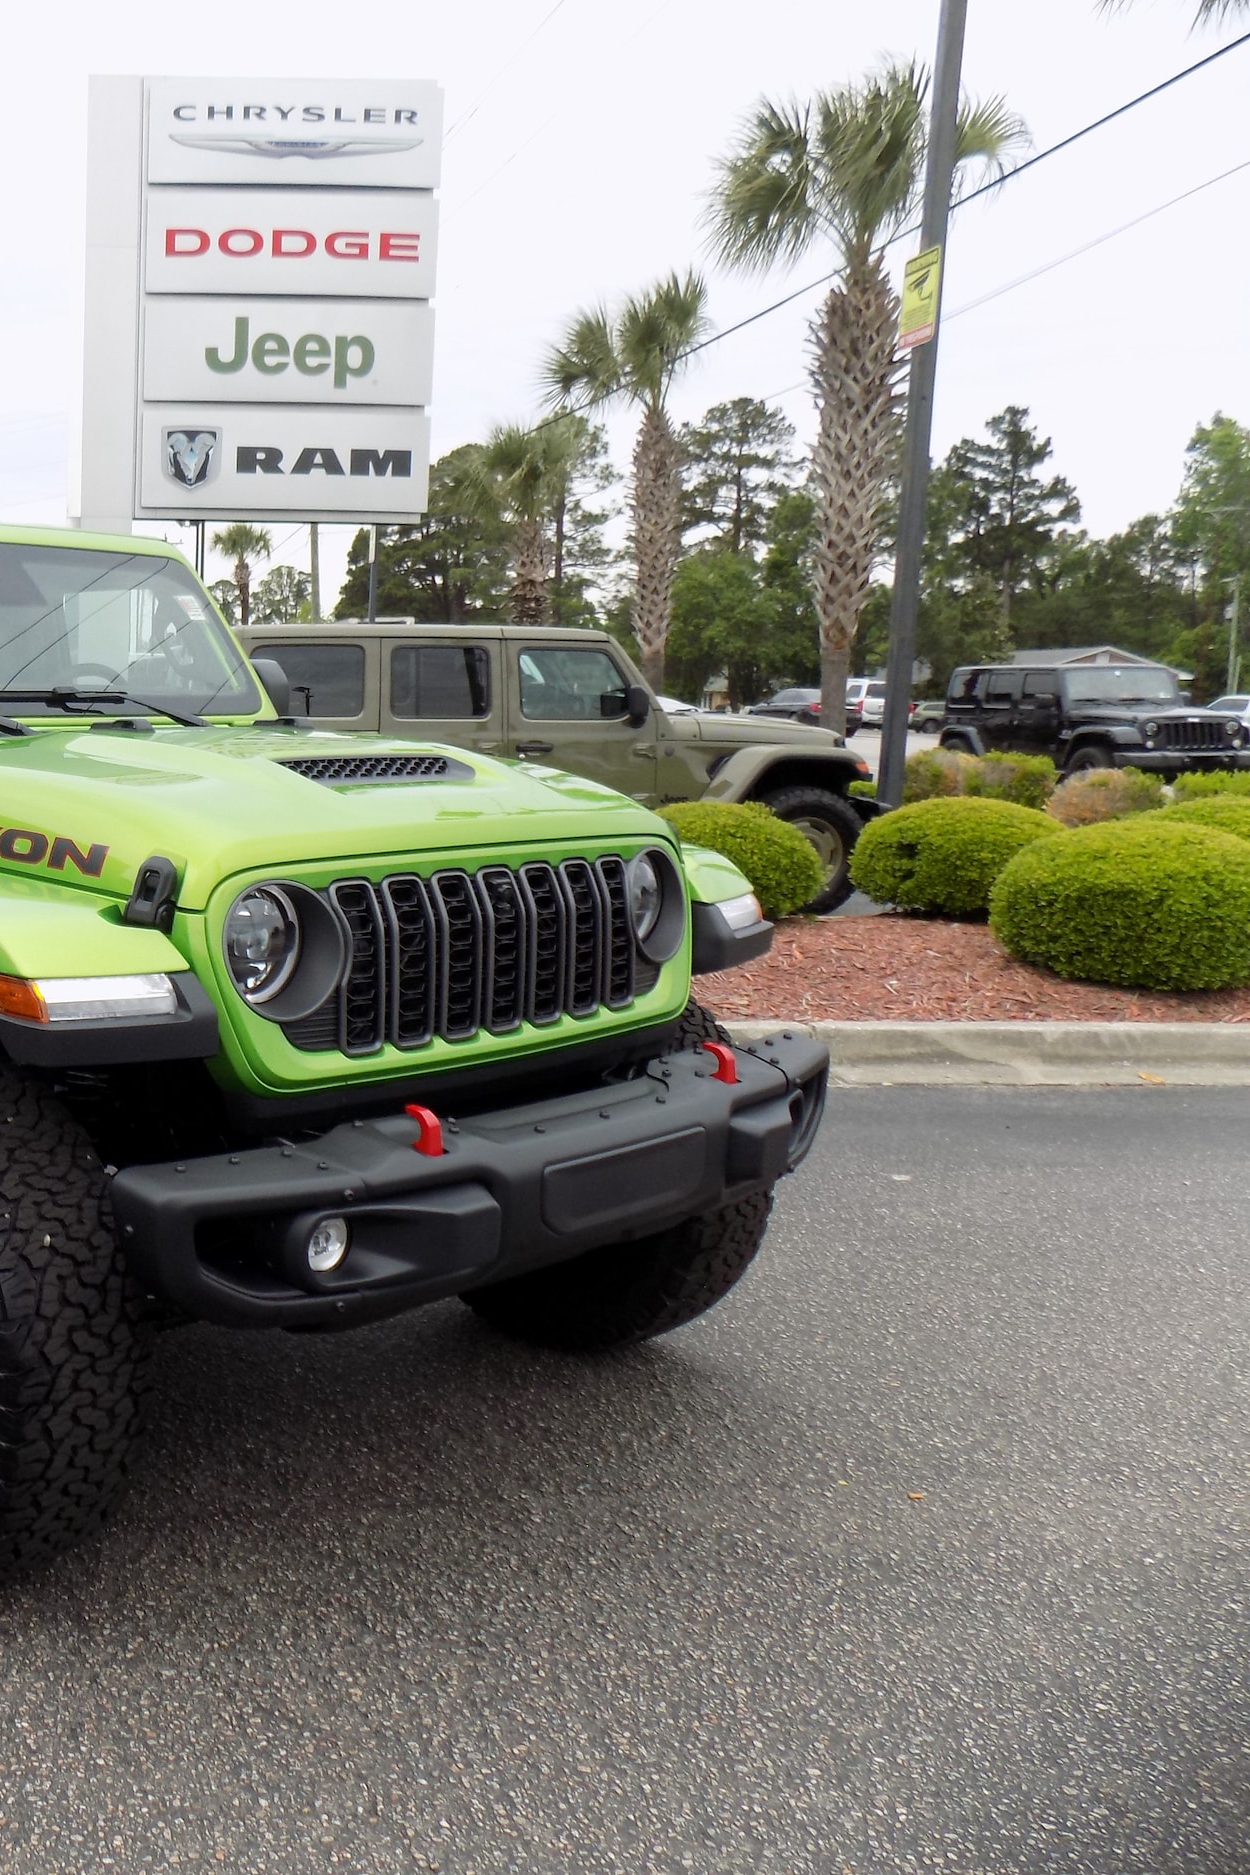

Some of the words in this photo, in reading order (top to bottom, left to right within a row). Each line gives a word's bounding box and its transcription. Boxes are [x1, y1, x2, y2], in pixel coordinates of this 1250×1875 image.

[172, 104, 419, 125] CHRYSLER
[164, 227, 420, 262] DODGE
[204, 316, 376, 389] Jeep
[236, 445, 412, 478] RAM
